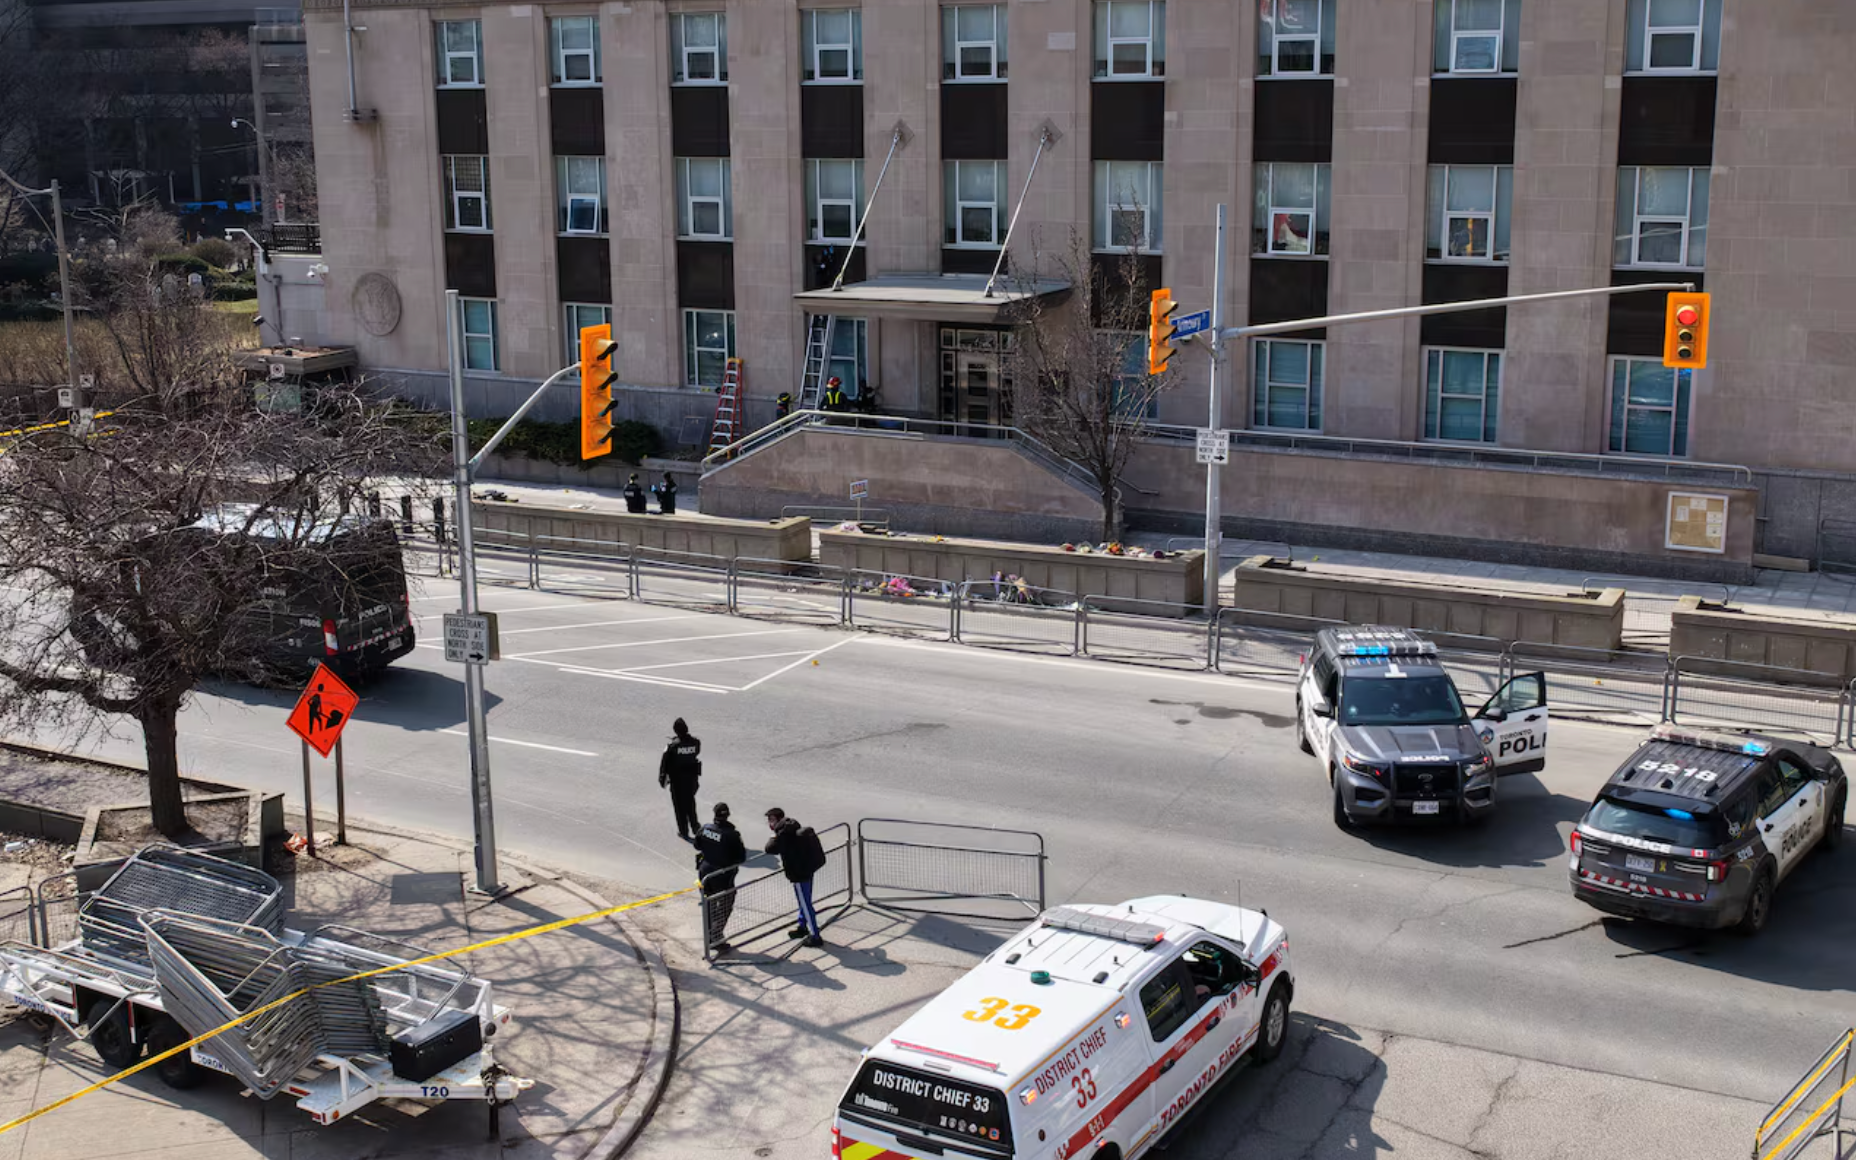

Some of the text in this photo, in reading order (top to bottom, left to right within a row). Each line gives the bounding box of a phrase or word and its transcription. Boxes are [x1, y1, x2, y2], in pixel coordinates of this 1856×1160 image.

[446, 617, 485, 630] PEDESTRIANS
[450, 628, 482, 640] CROSS AT
[448, 639, 484, 651] NORTH SIDE
[448, 649, 463, 659] ONLY
[1500, 729, 1532, 741] TORONTO
[677, 746, 696, 755] POLICE
[1639, 760, 1717, 781] 5218
[703, 828, 722, 842] POLICE
[1781, 815, 1812, 860] POLICE
[1611, 833, 1672, 854] POLICE
[14, 995, 45, 1011] TORONTO
[961, 996, 1041, 1030] 33
[1034, 1026, 1107, 1095] DISTRICT CHIEF
[1071, 1067, 1097, 1108] 33
[1161, 1064, 1216, 1129] TORONTO
[1217, 1036, 1244, 1072] FIRE
[421, 1086, 449, 1097] T20
[873, 1069, 990, 1113] DISTRICT CHIEF 33
[888, 1103, 899, 1115] Fire
[1088, 1114, 1105, 1137] 9-1-1
